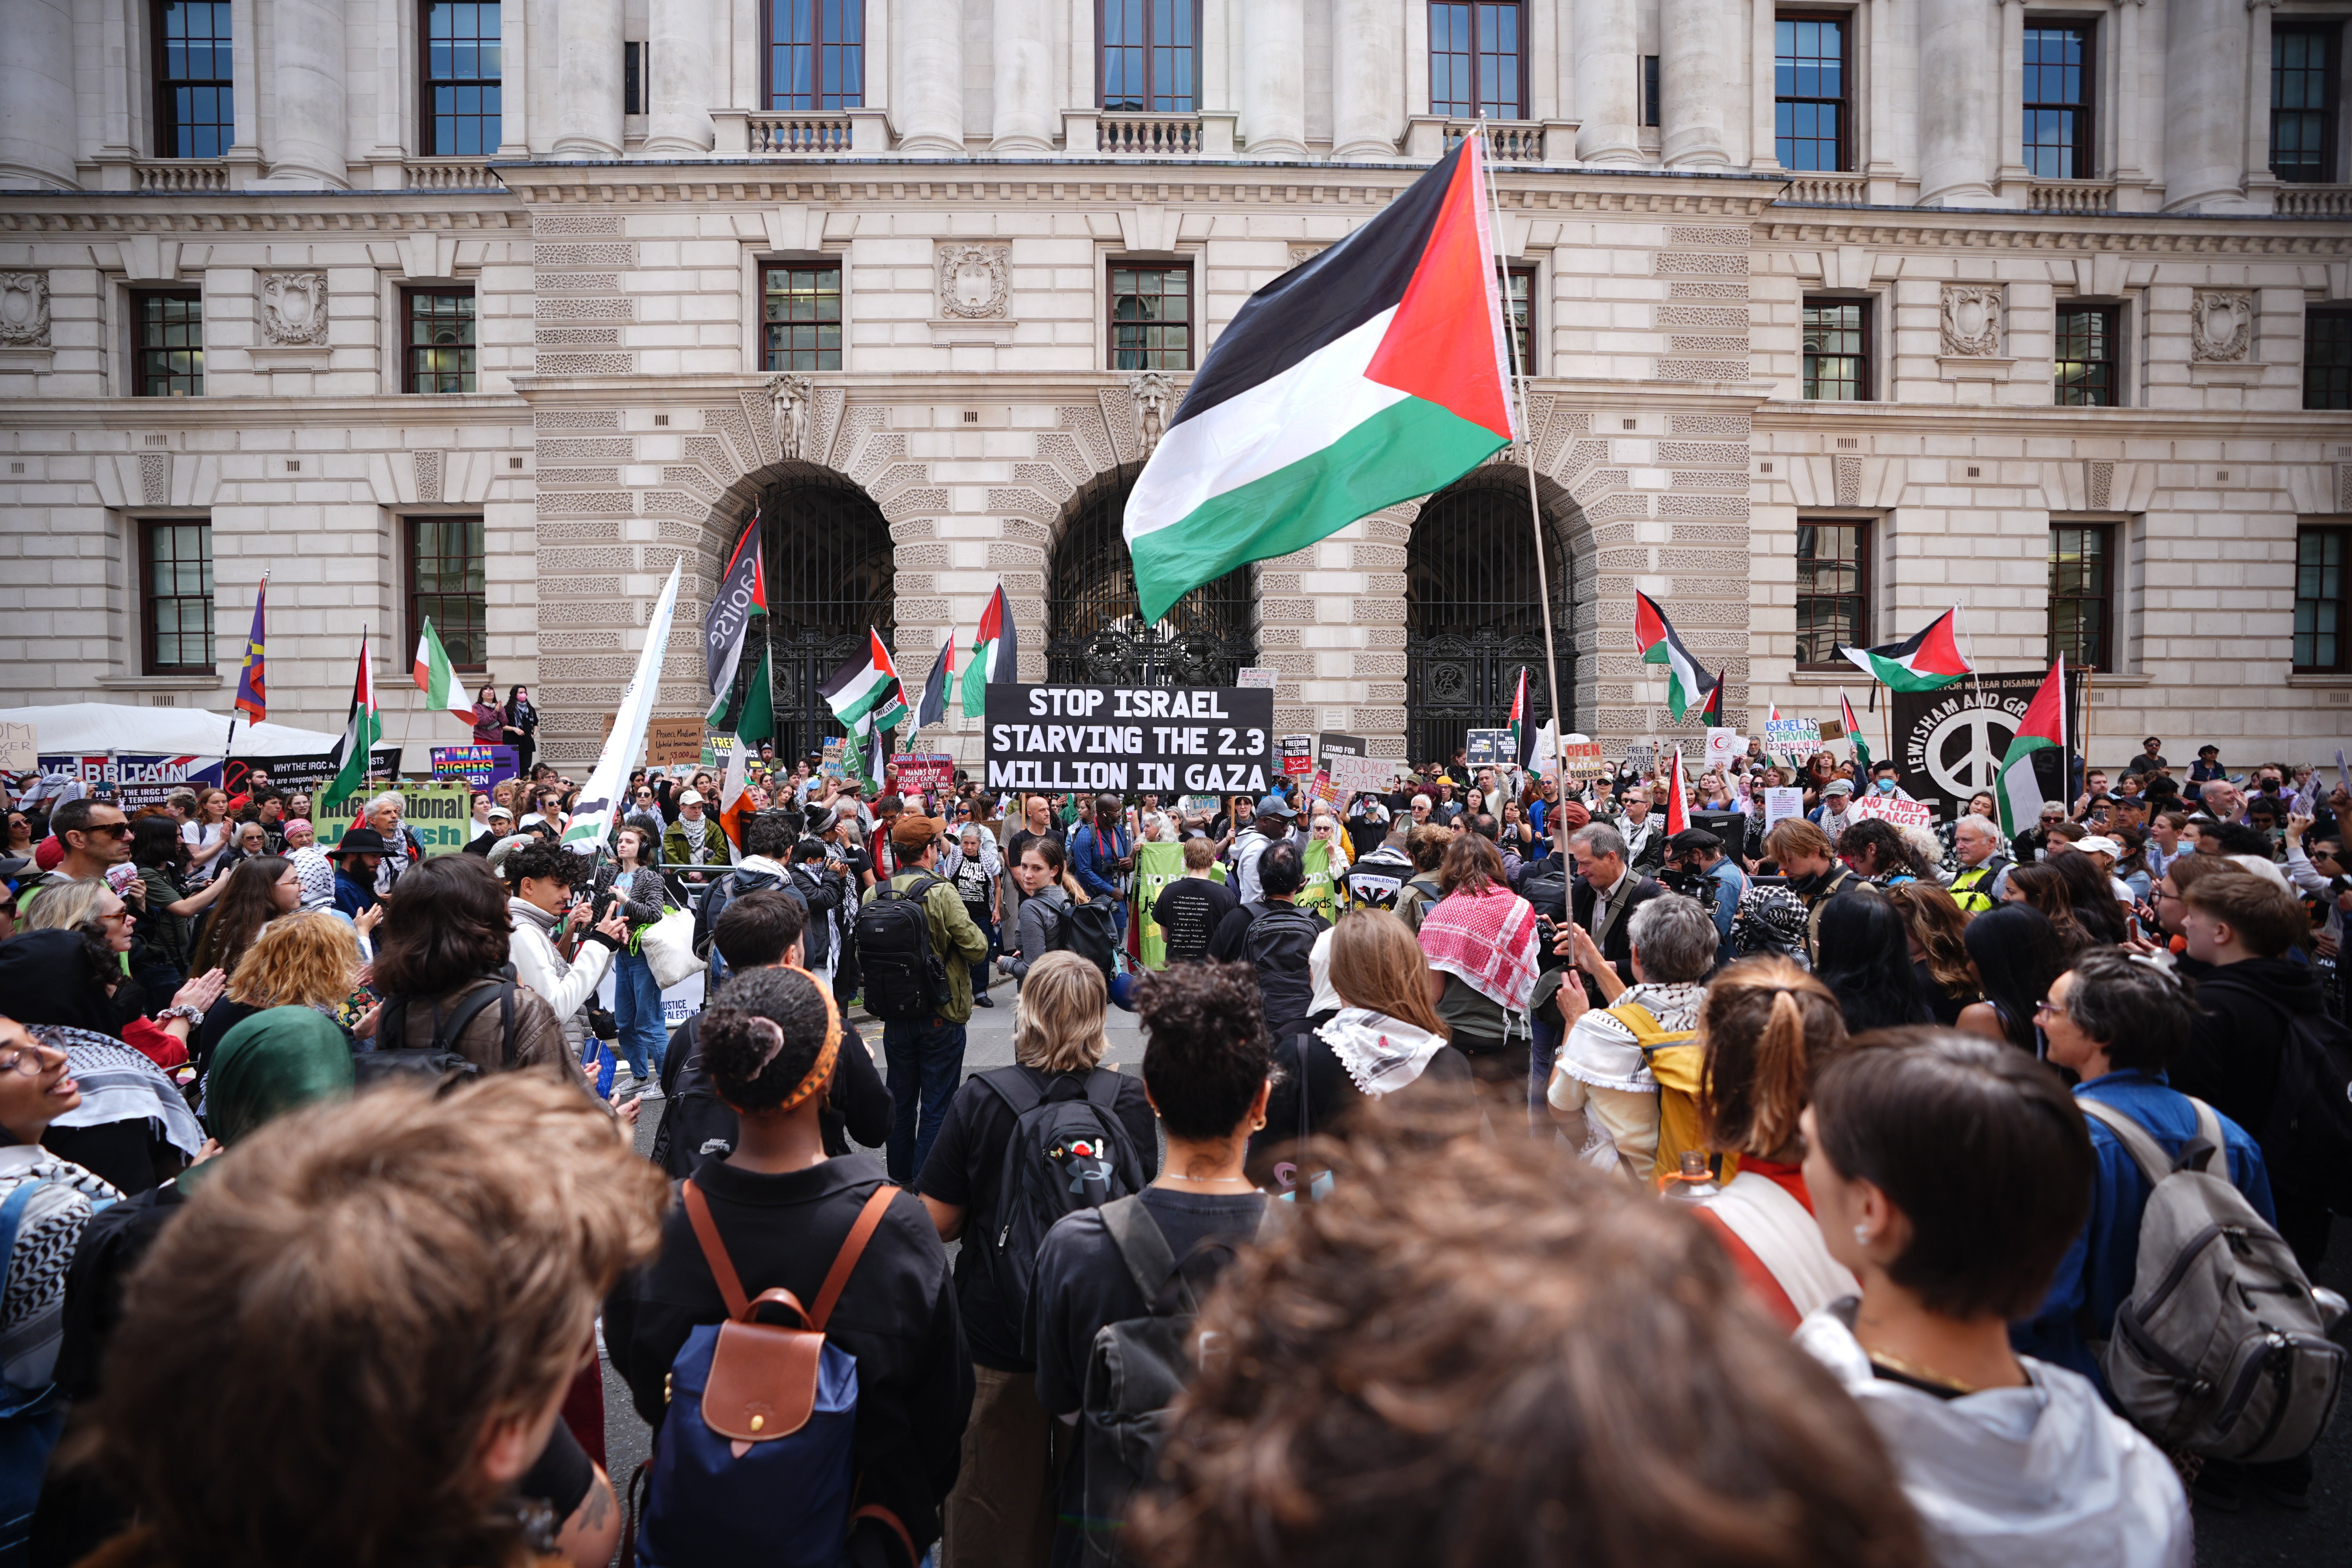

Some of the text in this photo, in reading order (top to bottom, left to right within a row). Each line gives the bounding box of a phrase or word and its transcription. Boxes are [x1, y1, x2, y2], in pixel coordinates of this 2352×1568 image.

[1029, 688, 1229, 719] STOP ISRAEL
[1766, 718, 1817, 731] ISRAEL IS
[1767, 730, 1820, 742] STARVING
[1907, 693, 2000, 773] LEWISHAM AND
[656, 740, 672, 750] Uphold
[993, 724, 1265, 756] STARVING THE 2.3
[1780, 741, 1809, 750] MILLION
[435, 746, 492, 761] HUMAN
[1326, 745, 1343, 753] STAND
[1567, 744, 1600, 757] OPEN
[274, 761, 327, 773] WHY THE IRGC
[437, 762, 493, 775] RIGHTS
[1336, 758, 1392, 776] SEND MORE
[84, 764, 187, 784] BRITAIN
[989, 760, 1267, 792] MILLION IN GAZA
[1570, 769, 1602, 779] BORDER
[1343, 775, 1381, 789] BOATS
[1862, 796, 1882, 808] NO
[1889, 800, 1924, 813] CHILD
[1858, 809, 1868, 819] A
[1876, 810, 1928, 826] TARGET
[959, 866, 986, 882] ISRAEL
[1145, 873, 1163, 886] TO
[1361, 876, 1399, 885] WIMBLEDON
